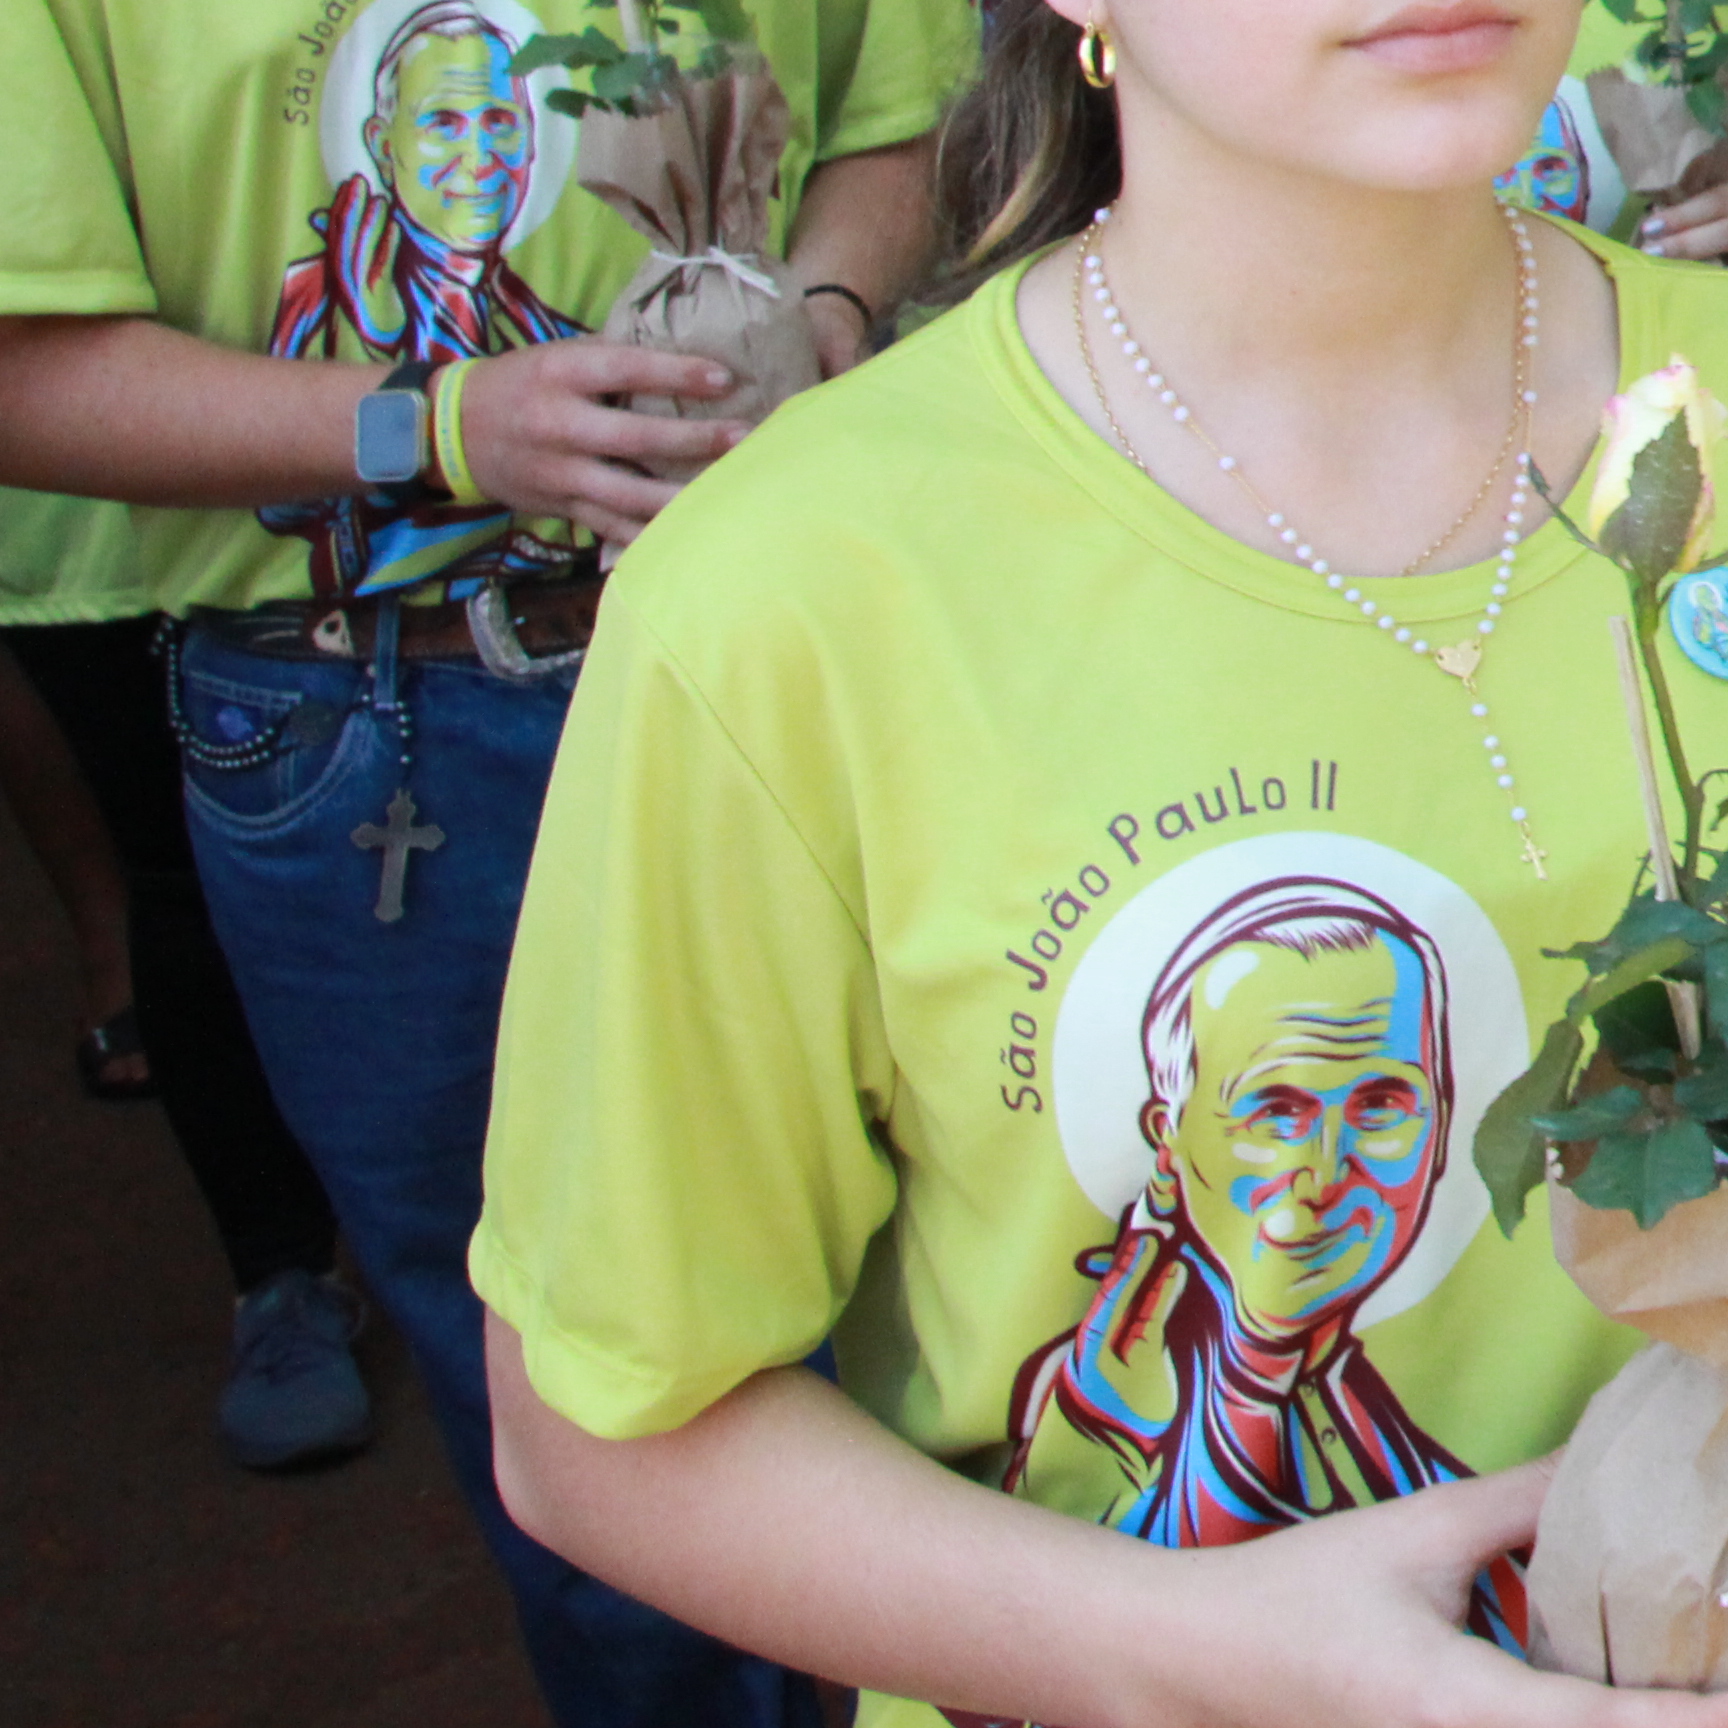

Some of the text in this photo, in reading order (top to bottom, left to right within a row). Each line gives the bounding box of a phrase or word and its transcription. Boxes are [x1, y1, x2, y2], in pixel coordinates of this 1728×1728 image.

[284, 68, 316, 126] São
[1310, 759, 1338, 811] II
[1005, 863, 1111, 992] João
[1000, 1010, 1044, 1114] São
